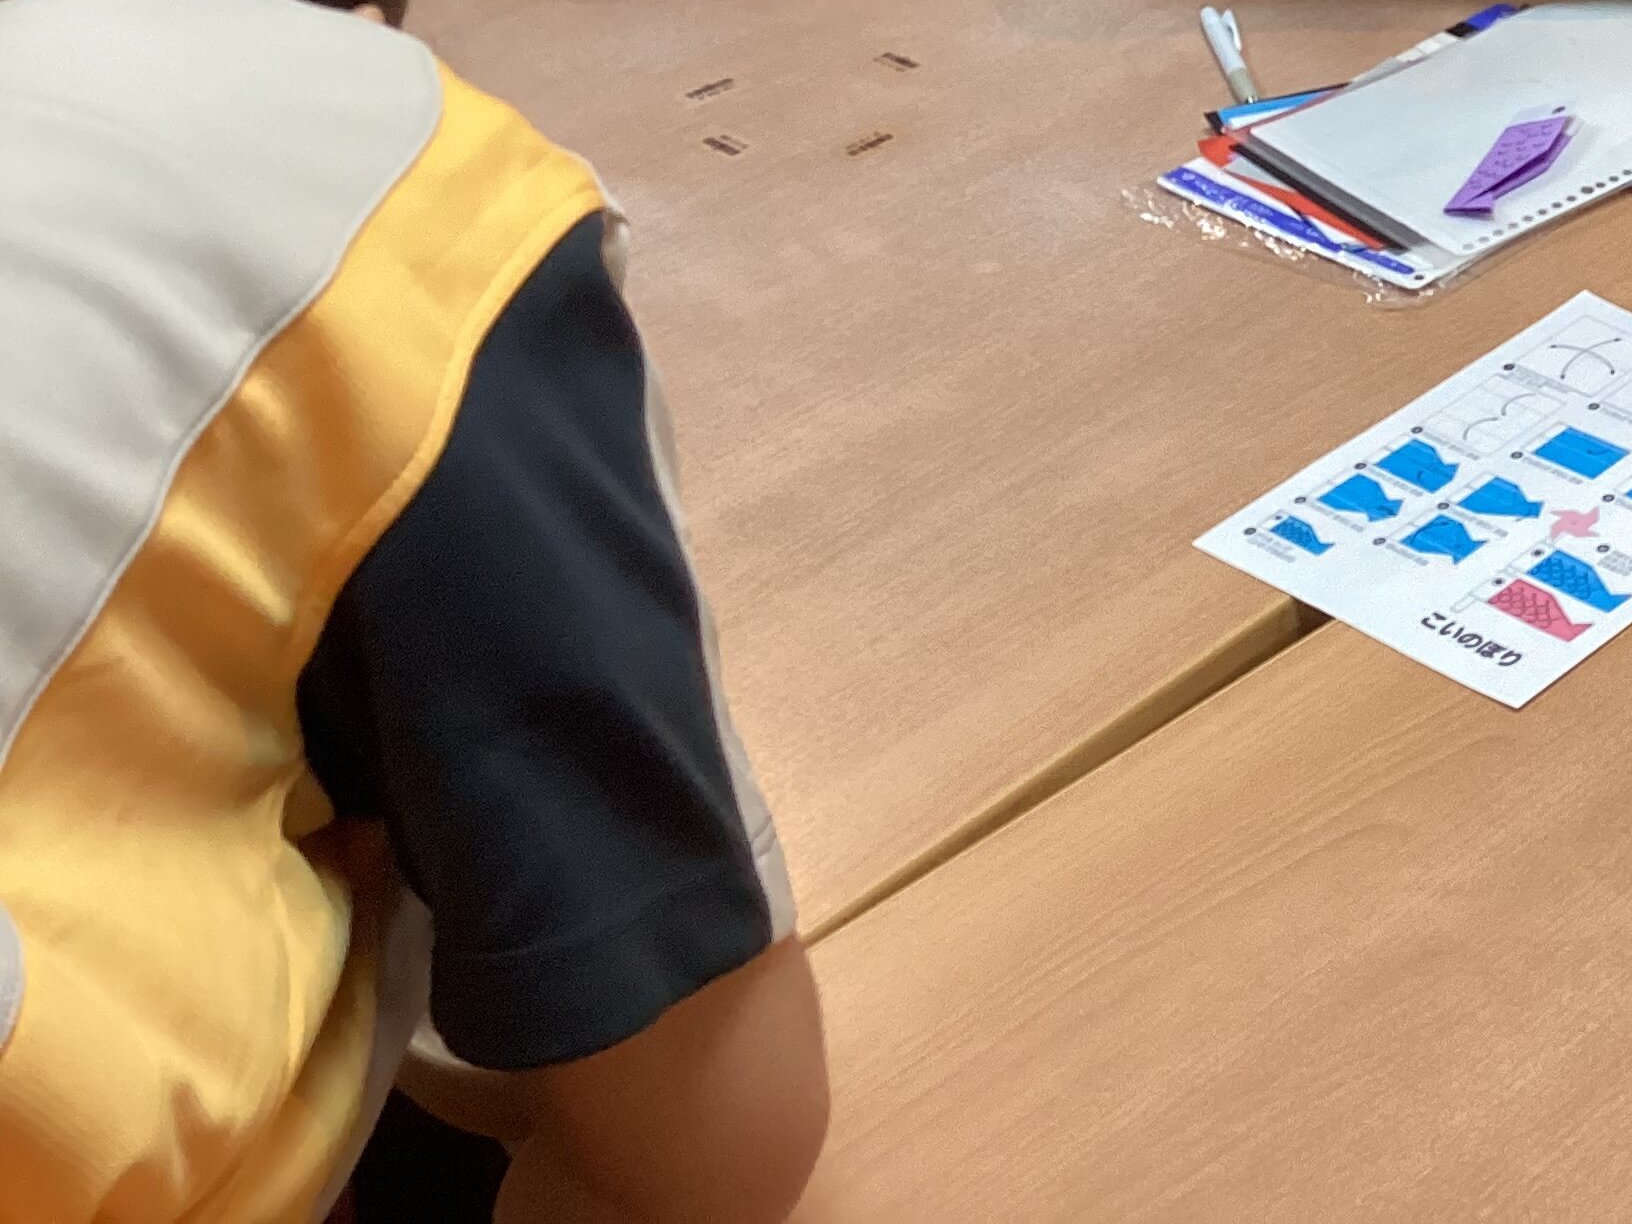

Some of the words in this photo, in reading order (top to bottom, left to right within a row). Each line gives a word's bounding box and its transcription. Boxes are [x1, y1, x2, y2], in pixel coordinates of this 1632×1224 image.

[1421, 612, 1522, 666] こいのぼり
